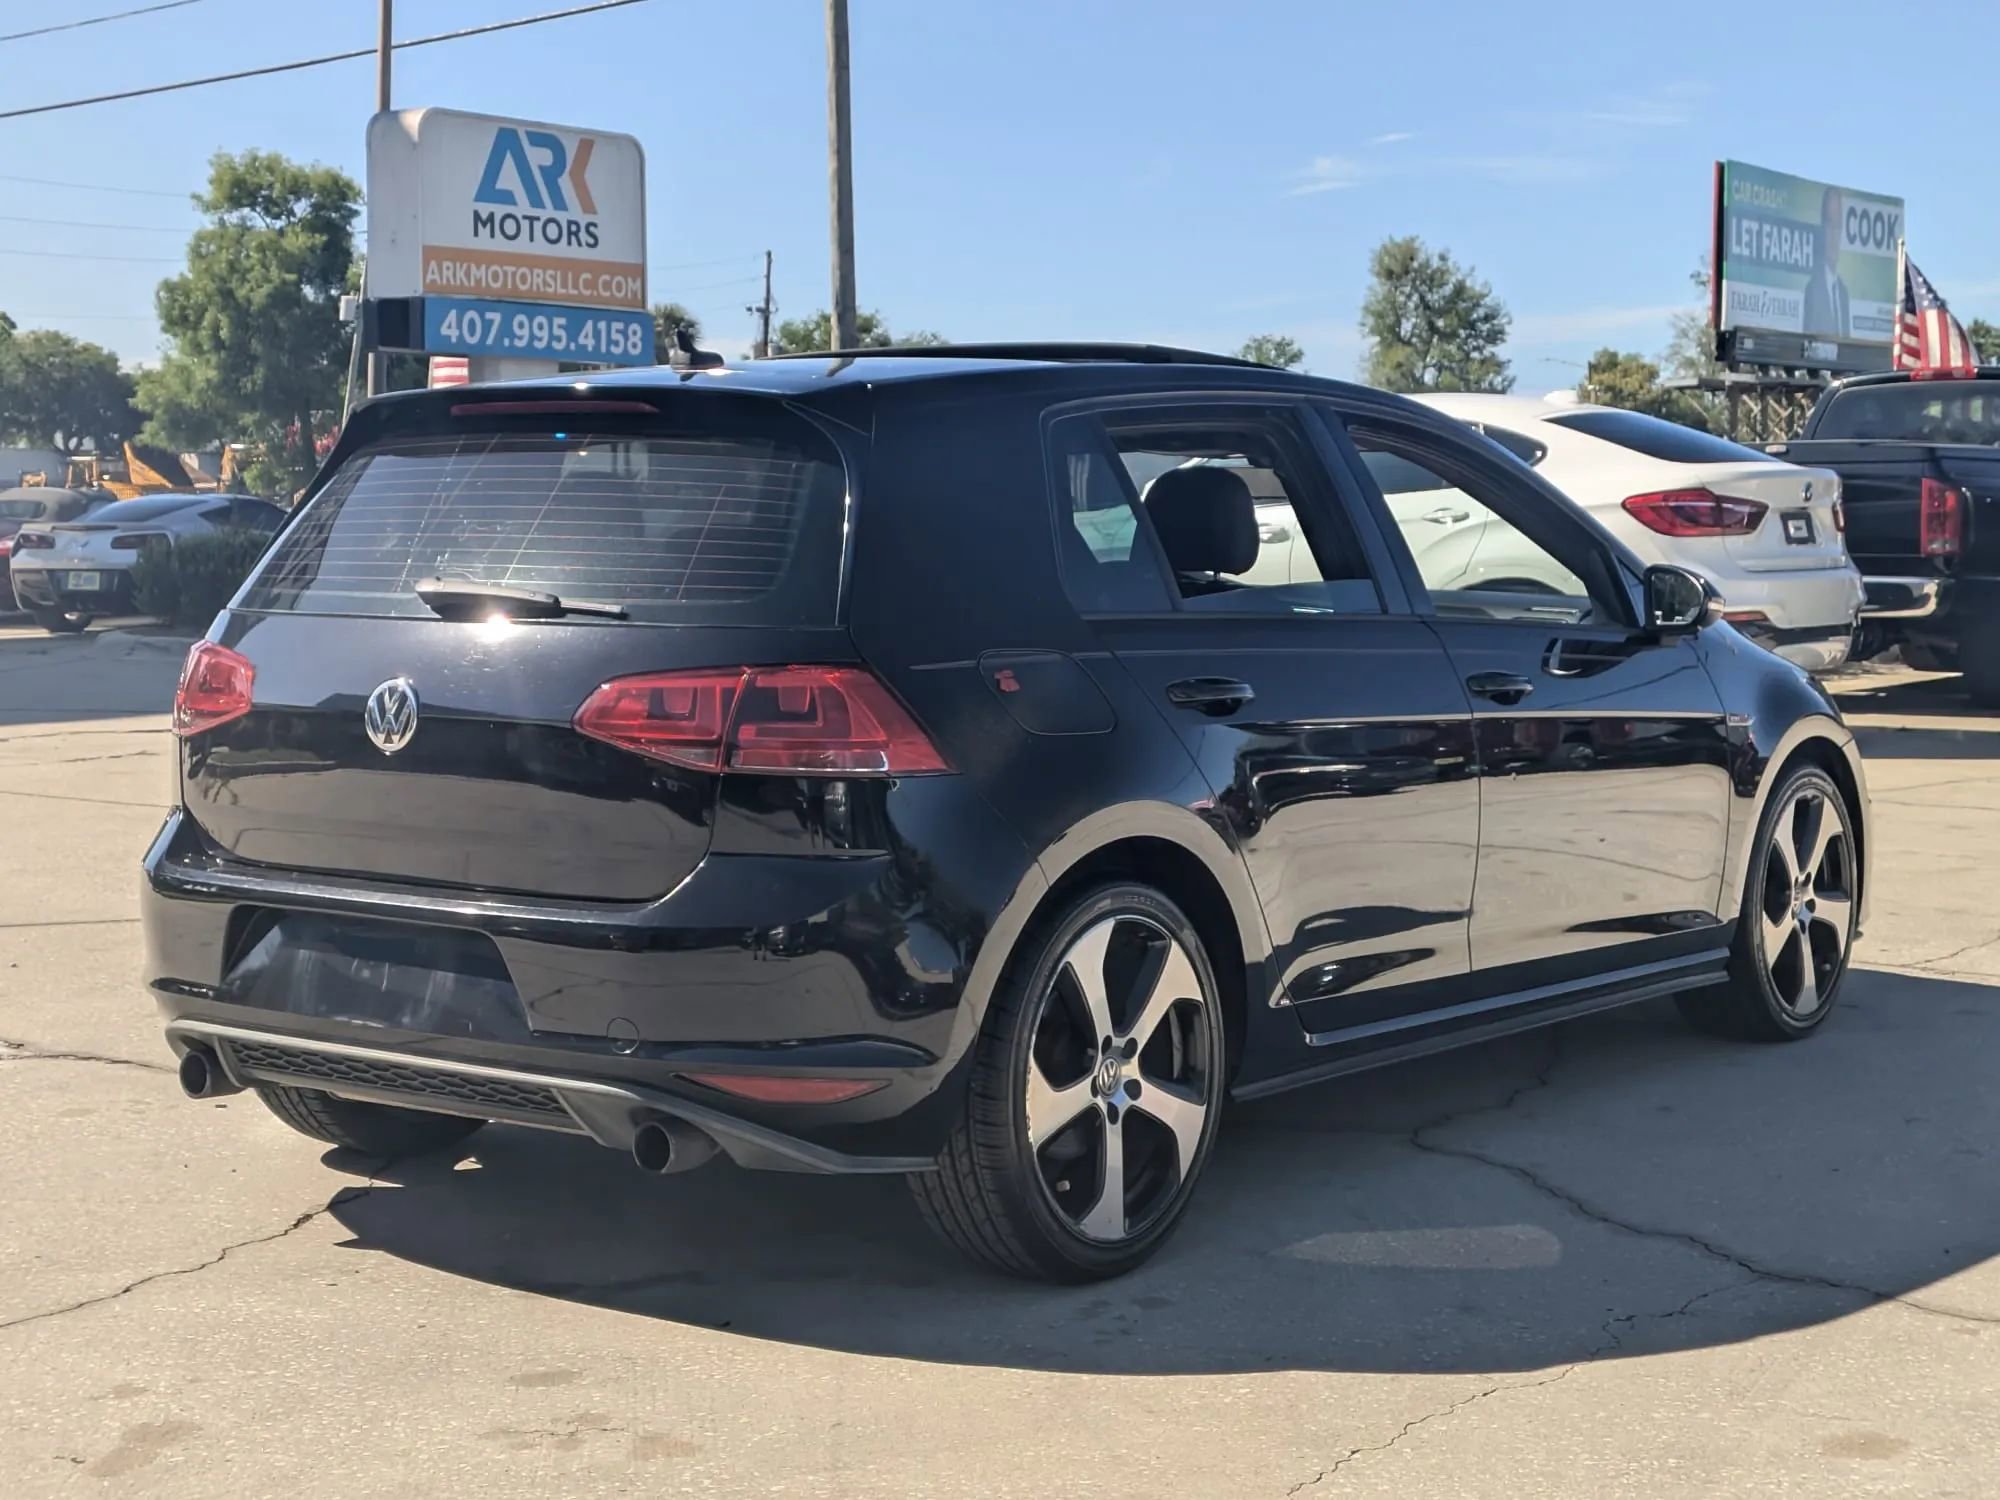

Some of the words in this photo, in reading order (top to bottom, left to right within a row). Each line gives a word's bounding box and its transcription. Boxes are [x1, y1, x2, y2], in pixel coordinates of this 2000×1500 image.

[473, 126, 598, 215] ARK
[473, 209, 599, 248] MOTORS
[1732, 216, 1759, 260] LET
[1762, 223, 1814, 268] FARAH
[1845, 205, 1900, 250] COOK
[425, 259, 642, 299] ARKMOTORSLLC.COM
[439, 309, 643, 356] 407.995.4158
